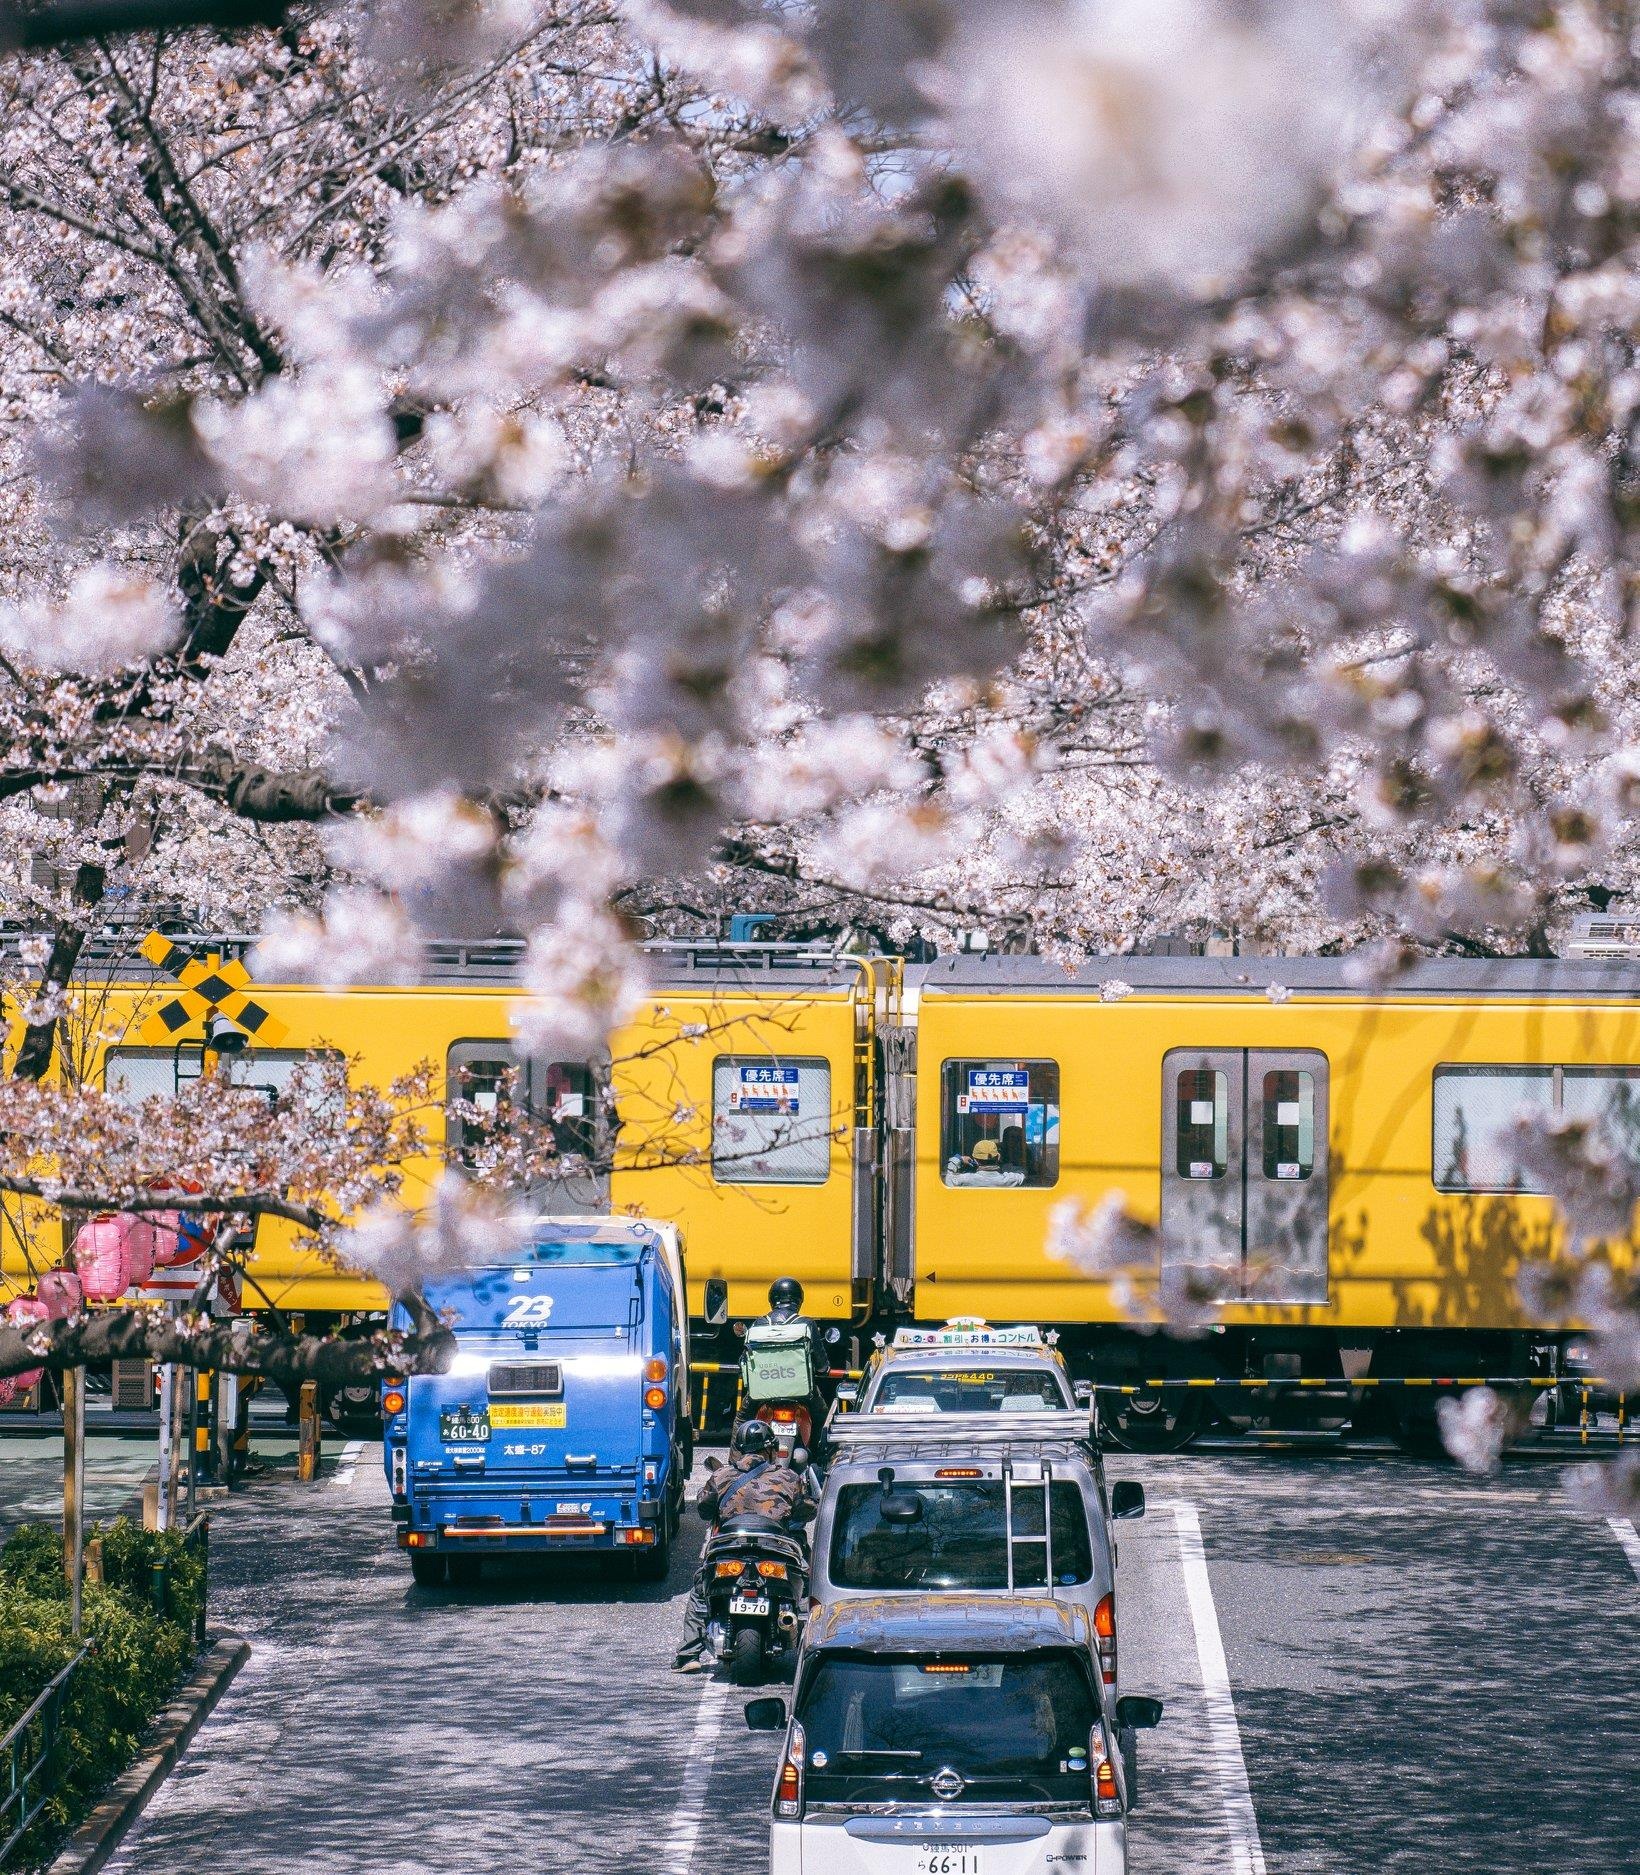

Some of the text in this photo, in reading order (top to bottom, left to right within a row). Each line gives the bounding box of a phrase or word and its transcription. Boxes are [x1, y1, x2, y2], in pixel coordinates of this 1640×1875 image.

[746, 1069, 785, 1082] 優先席
[974, 1073, 1014, 1085] 優先席
[503, 1295, 554, 1321] 23
[501, 1321, 548, 1329] TOKYO
[759, 1366, 796, 1380] eats
[450, 1424, 489, 1439] 60-40
[734, 1603, 766, 1613] 19-70
[929, 1855, 977, 1874] 66-11
